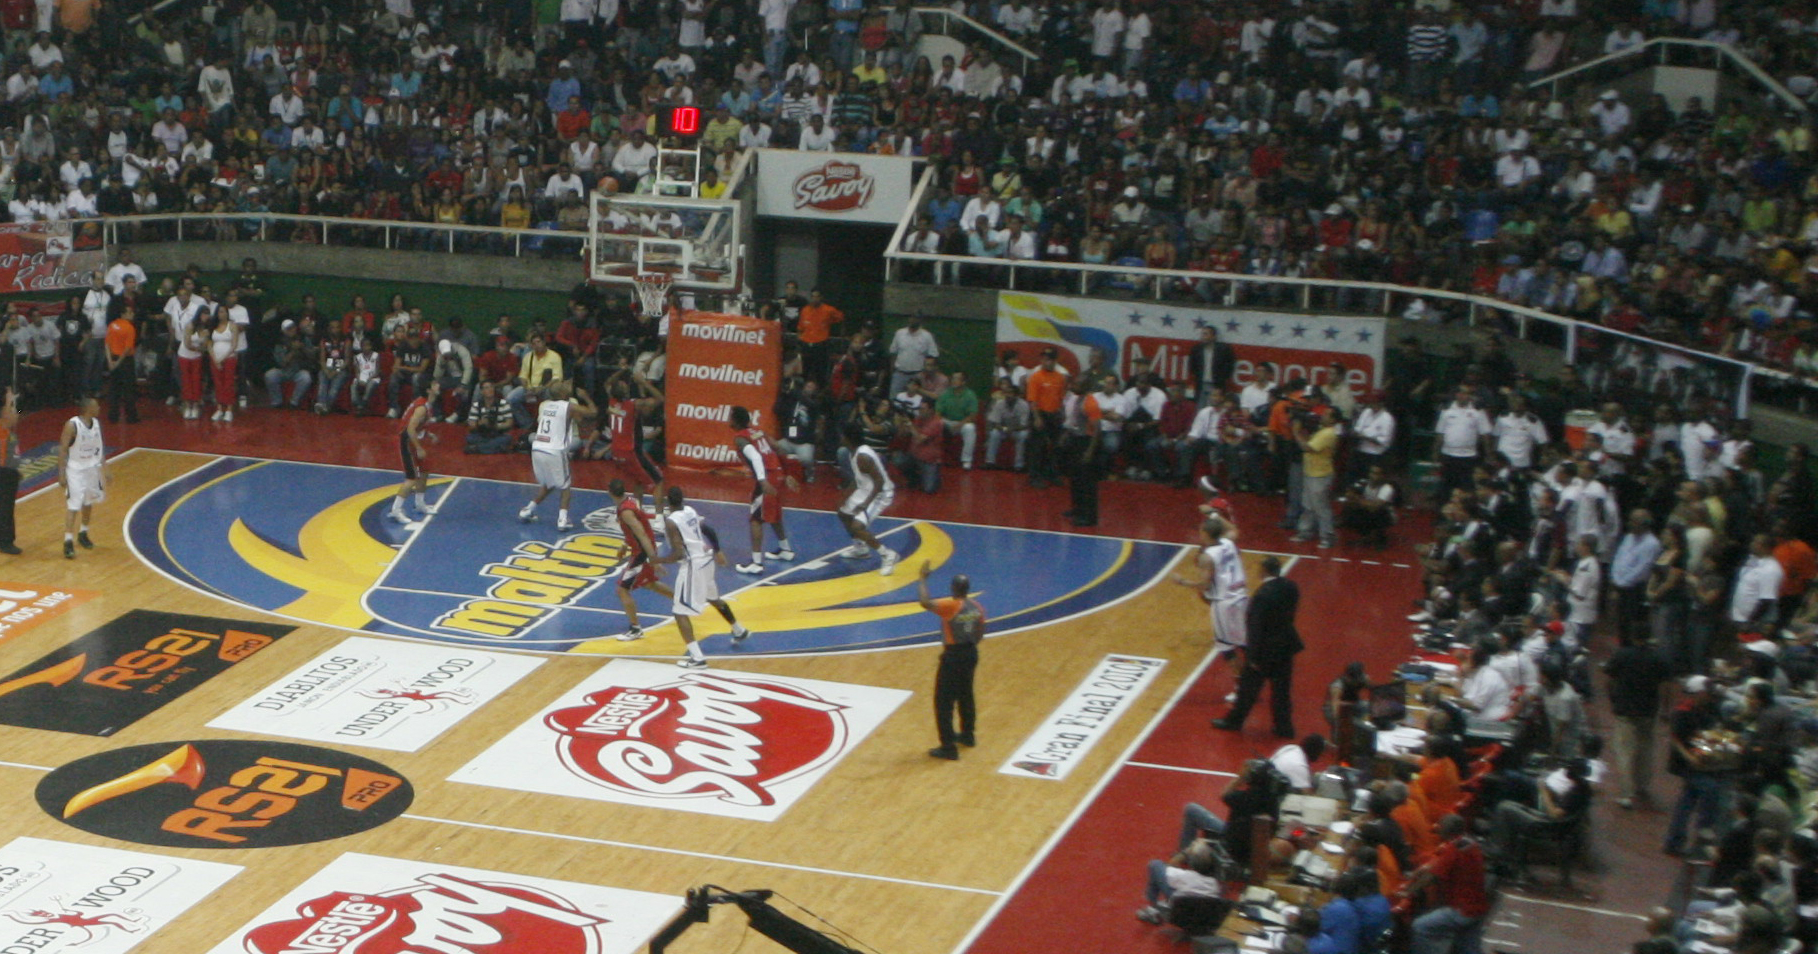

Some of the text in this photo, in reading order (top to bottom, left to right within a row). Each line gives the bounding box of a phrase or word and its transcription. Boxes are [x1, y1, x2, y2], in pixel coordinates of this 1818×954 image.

[673, 108, 698, 132] 10
[794, 174, 874, 210] Savoy
[682, 323, 765, 345] movilnet
[679, 362, 763, 386] movilnet
[541, 419, 551, 434] 13
[610, 413, 622, 433] 11
[1, 606, 43, 623] nos
[33, 591, 73, 608] une
[83, 628, 220, 690] RS21
[227, 638, 264, 657] PRO
[253, 656, 358, 711] DIABLITOS
[336, 657, 474, 737] UNDER WOOD
[1026, 663, 1149, 762] Gran Final 2010
[597, 673, 852, 806] Savoy
[161, 756, 342, 843] RS21
[346, 780, 390, 804] PRO
[73, 866, 155, 907] WOOD
